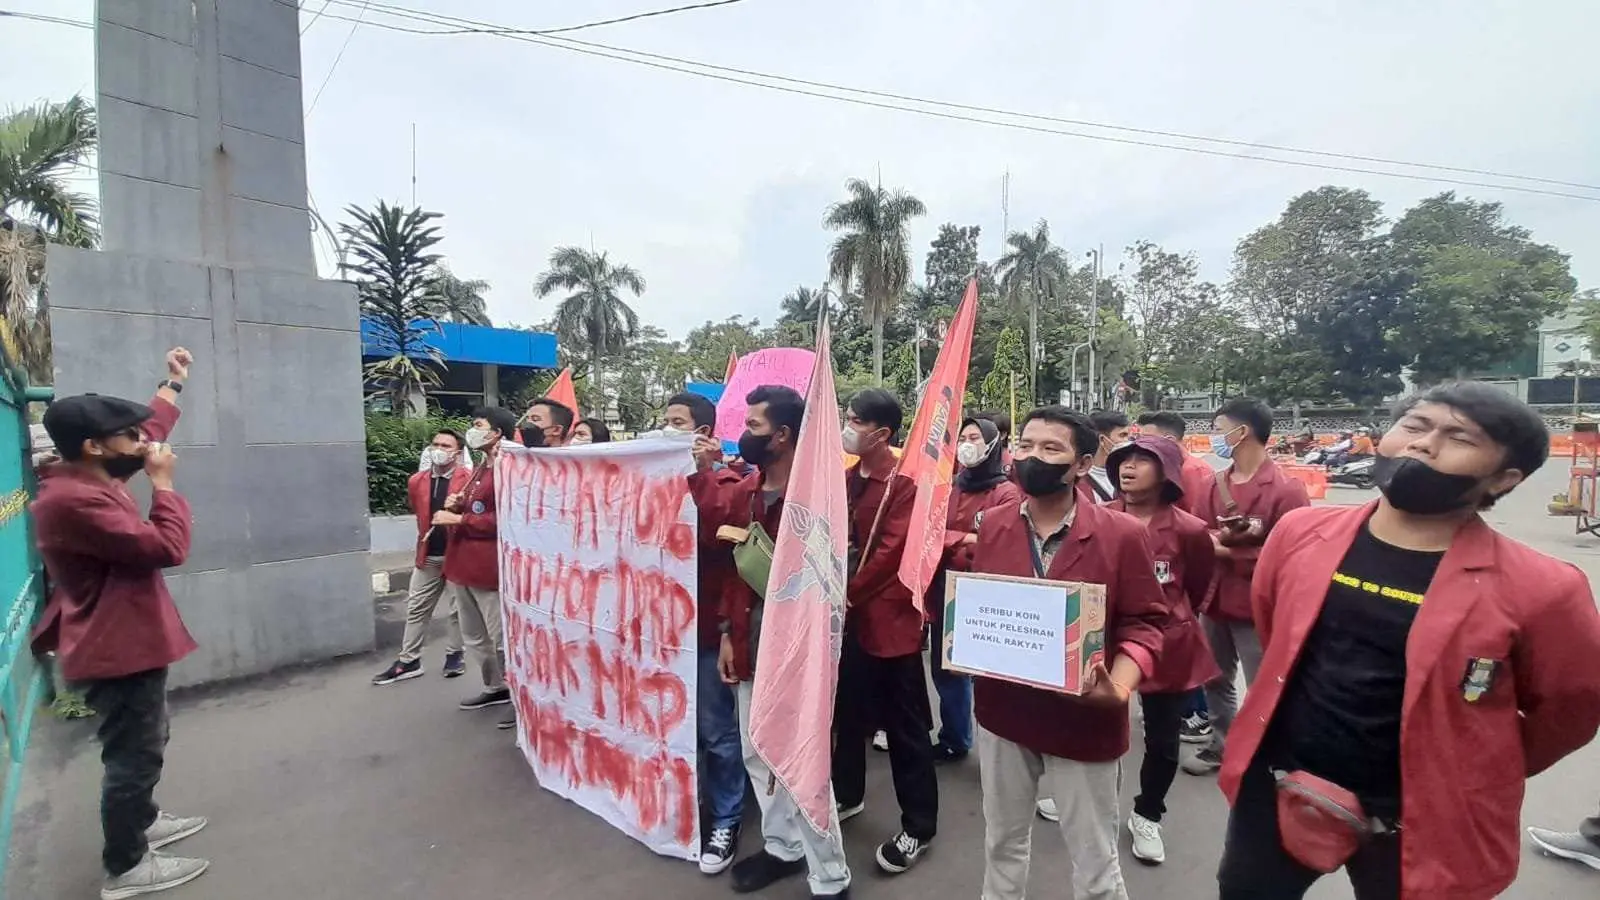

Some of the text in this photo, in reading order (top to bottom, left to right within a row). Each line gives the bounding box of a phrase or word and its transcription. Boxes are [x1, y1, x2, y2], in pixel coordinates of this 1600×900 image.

[978, 606, 1041, 621] SERIBU KOIN
[965, 617, 1055, 638] UNTUK PELESIRAN
[972, 632, 1045, 651] WAKIL RAKYAT
